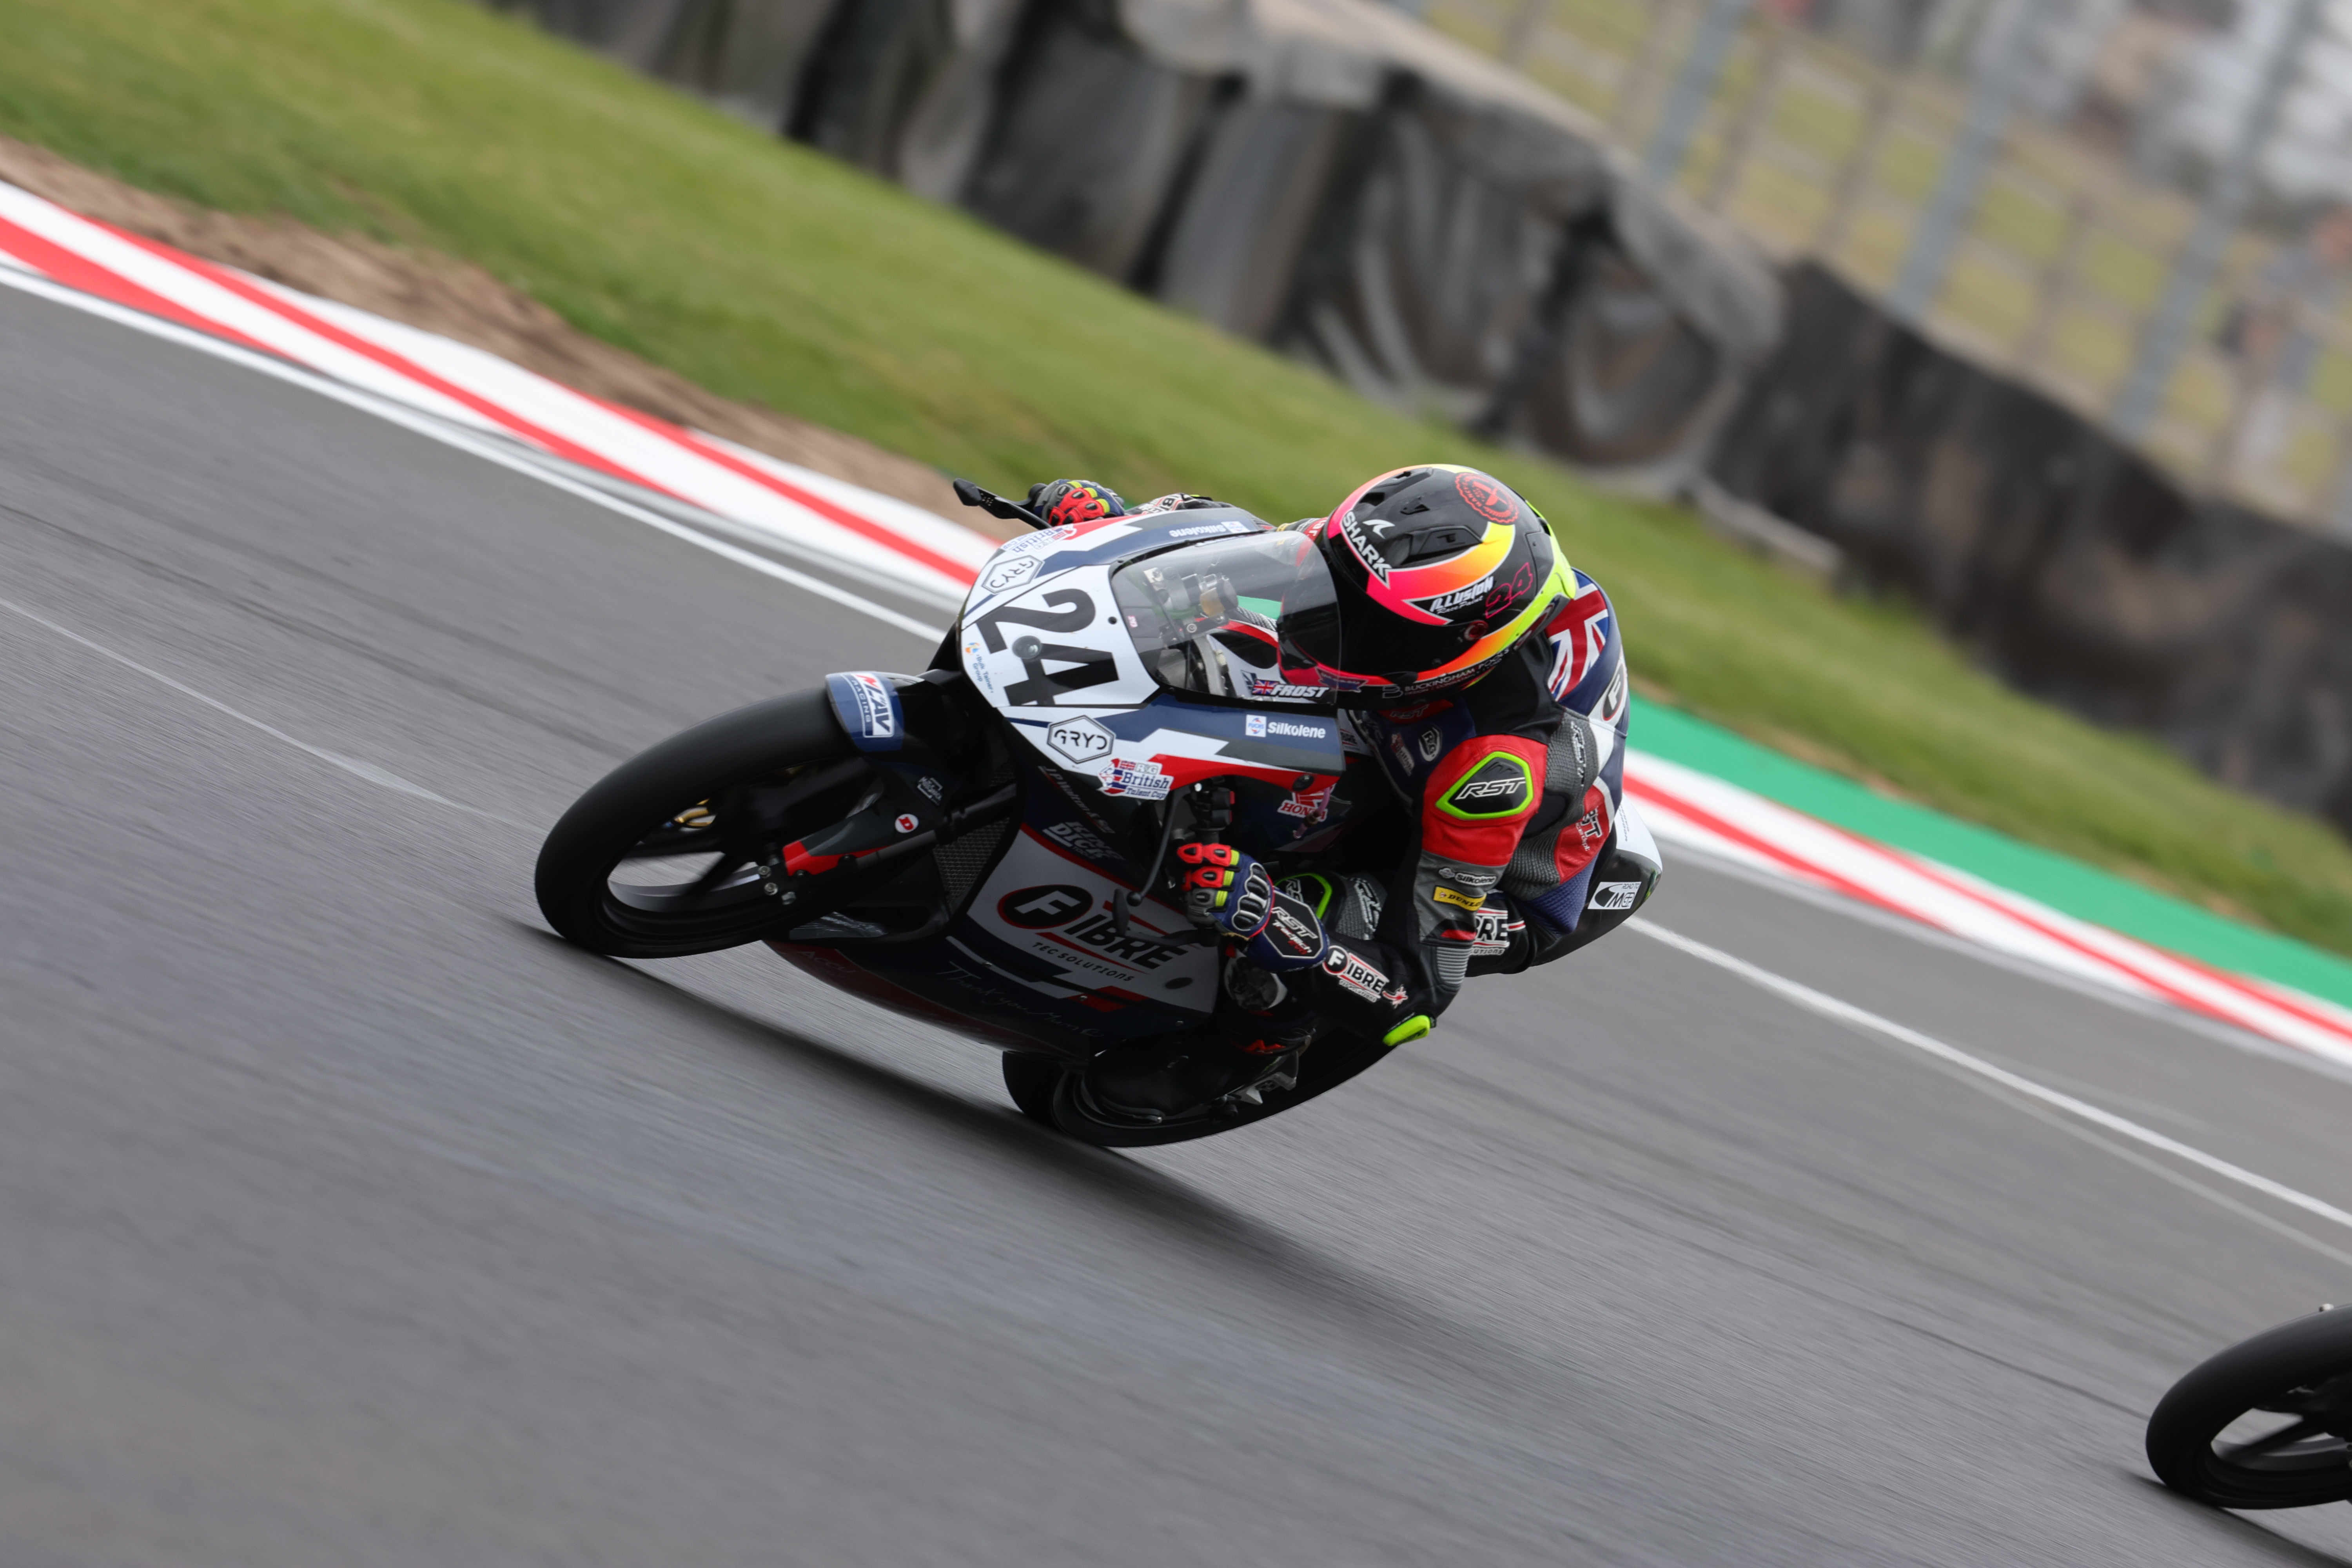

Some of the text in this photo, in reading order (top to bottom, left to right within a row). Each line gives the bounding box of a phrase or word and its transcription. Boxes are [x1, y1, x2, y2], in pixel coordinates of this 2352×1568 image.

[1012, 529, 1056, 553] British
[1343, 511, 1392, 577] SHARK
[990, 561, 1035, 588] GRYD
[1430, 575, 1494, 612] ILLUSION
[1485, 562, 1534, 619] 24
[975, 588, 1120, 706] 24
[1270, 685, 1329, 697] FROST
[1404, 668, 1475, 692] BUCKINGHAM
[851, 679, 872, 723] RACING
[1054, 729, 1107, 750] GRYD
[1267, 722, 1326, 739] Silkolene
[1122, 771, 1170, 789] British
[1455, 777, 1526, 800] RST
[1125, 788, 1167, 800] Talent Cup
[1047, 822, 1106, 858] DICK
[1457, 874, 1496, 884] Silkolene
[1014, 890, 1189, 970] FIBRE
[1271, 906, 1319, 939] RST
[1033, 942, 1059, 955] TEC
[1327, 950, 1387, 993] FIBRE
